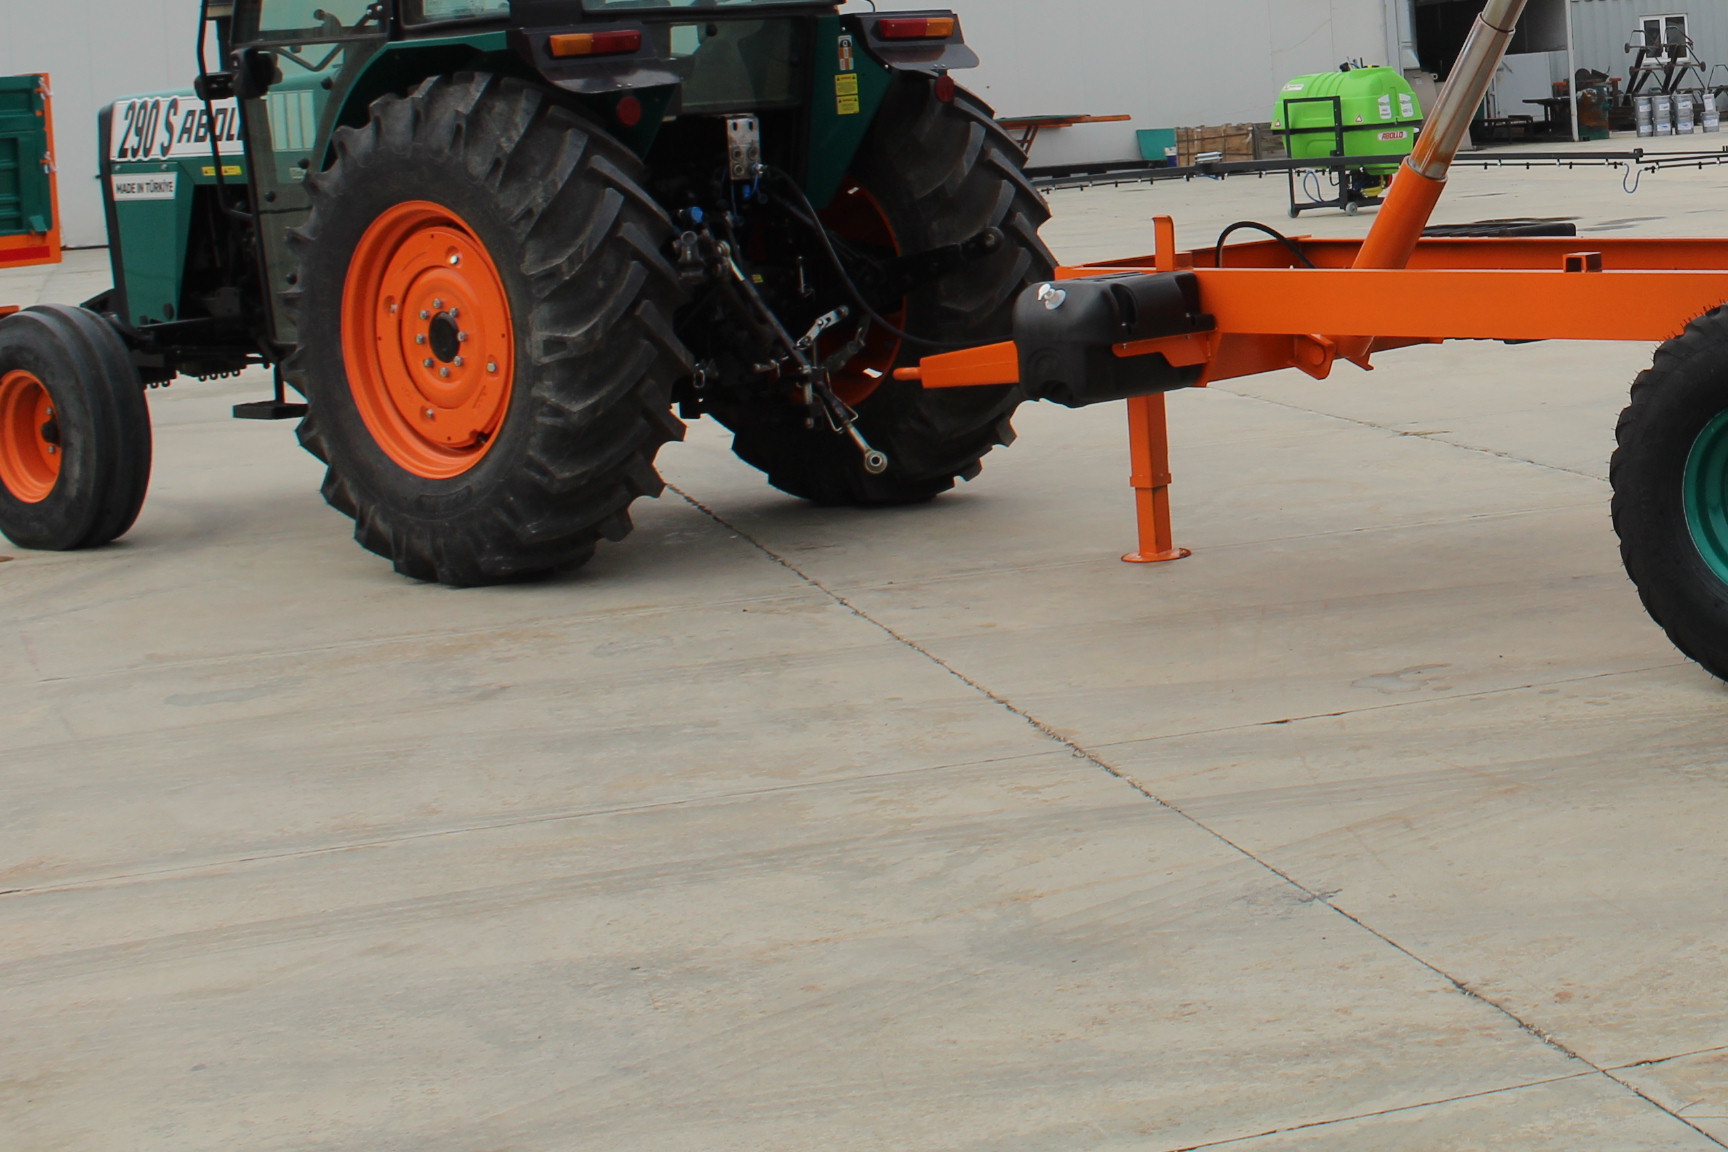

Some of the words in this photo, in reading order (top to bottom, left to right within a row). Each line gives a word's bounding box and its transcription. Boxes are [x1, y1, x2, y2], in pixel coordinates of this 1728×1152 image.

[118, 99, 161, 159] 290
[160, 97, 179, 158] S
[176, 107, 241, 143] ABOL
[116, 182, 136, 194] MADE
[137, 182, 145, 193] IN
